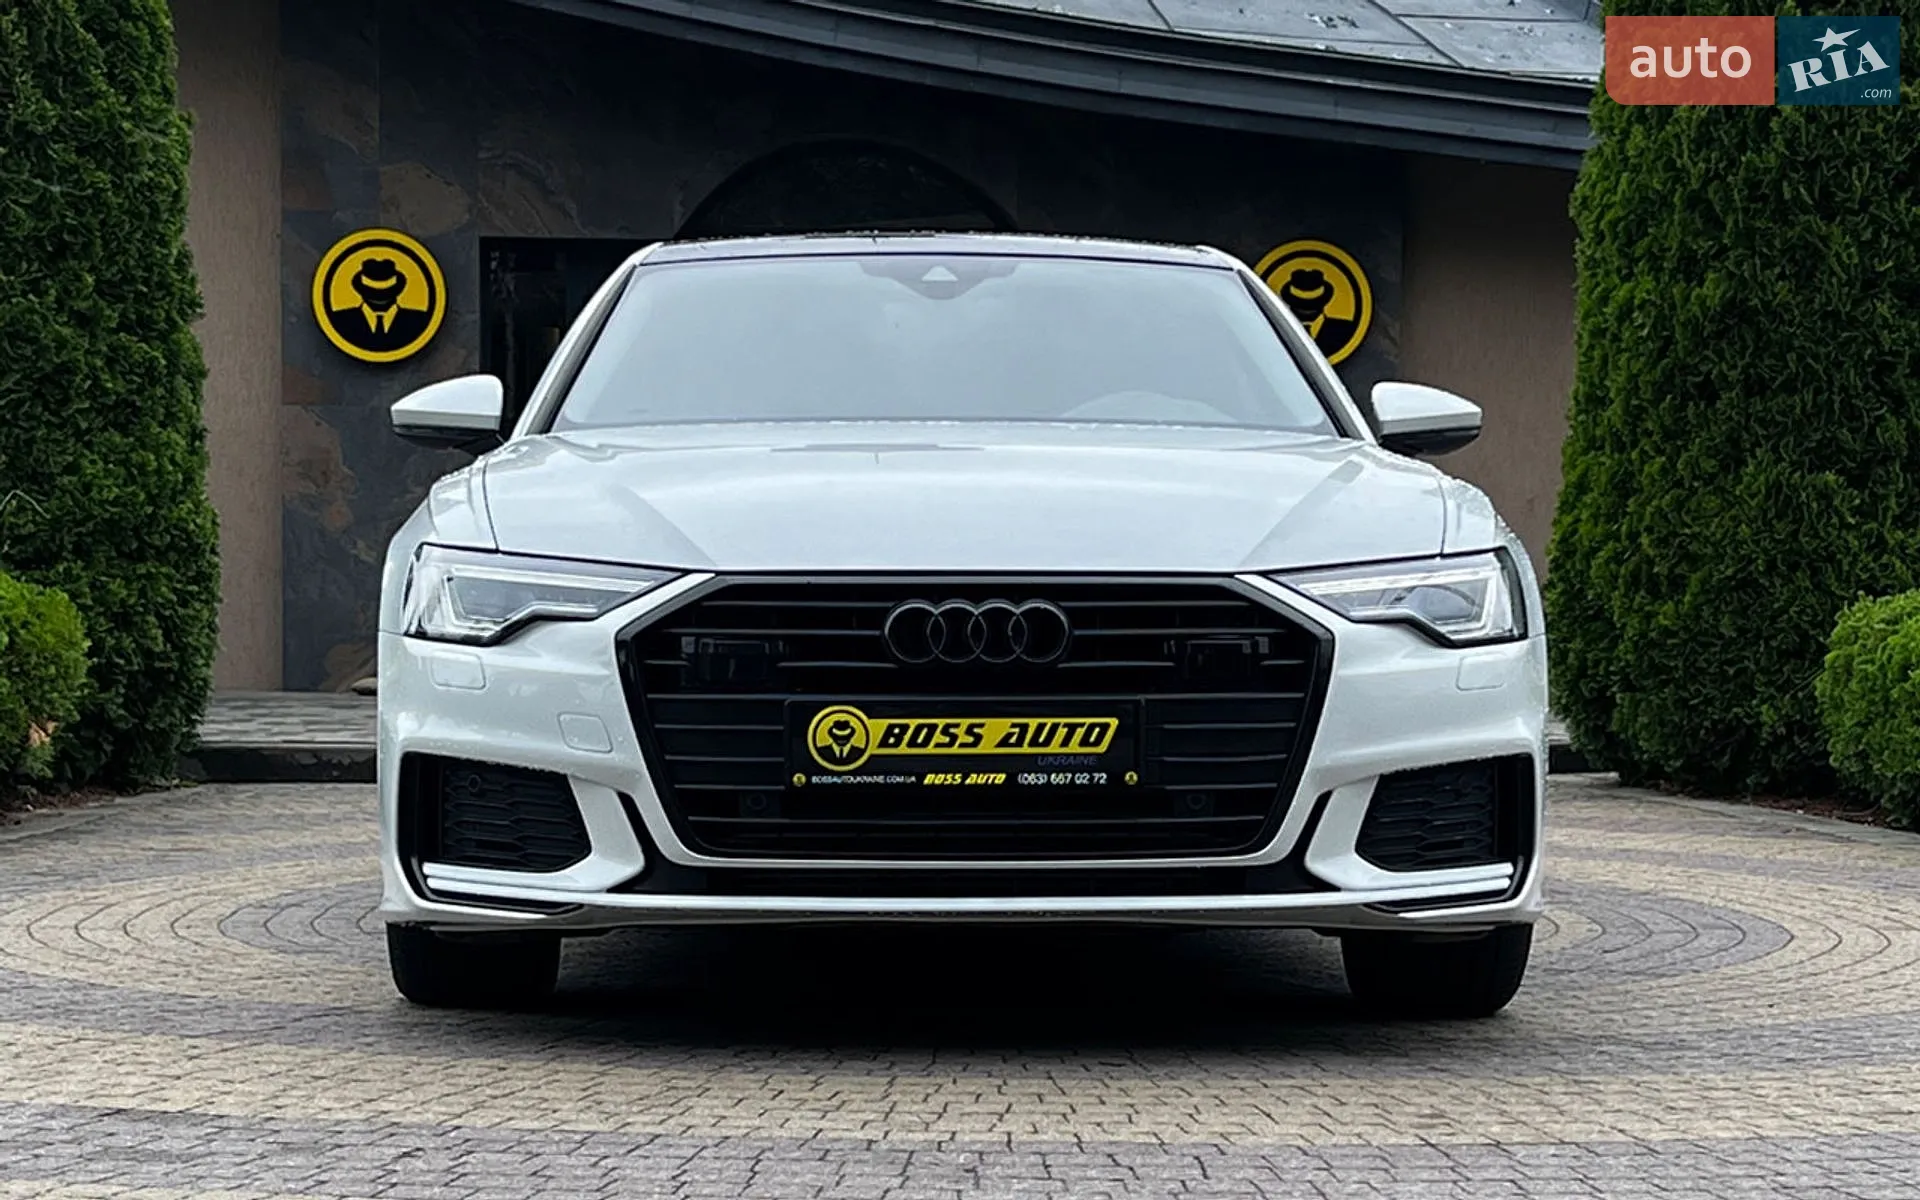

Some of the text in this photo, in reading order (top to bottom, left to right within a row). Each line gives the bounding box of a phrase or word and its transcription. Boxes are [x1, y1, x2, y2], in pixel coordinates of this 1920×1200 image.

[879, 722, 1113, 749] BOSS AUTO
[1037, 756, 1098, 767] UKRAINE
[923, 773, 1006, 785] BOSS AUTO
[1074, 773, 1090, 785] 02
[1092, 773, 1108, 785] 72
